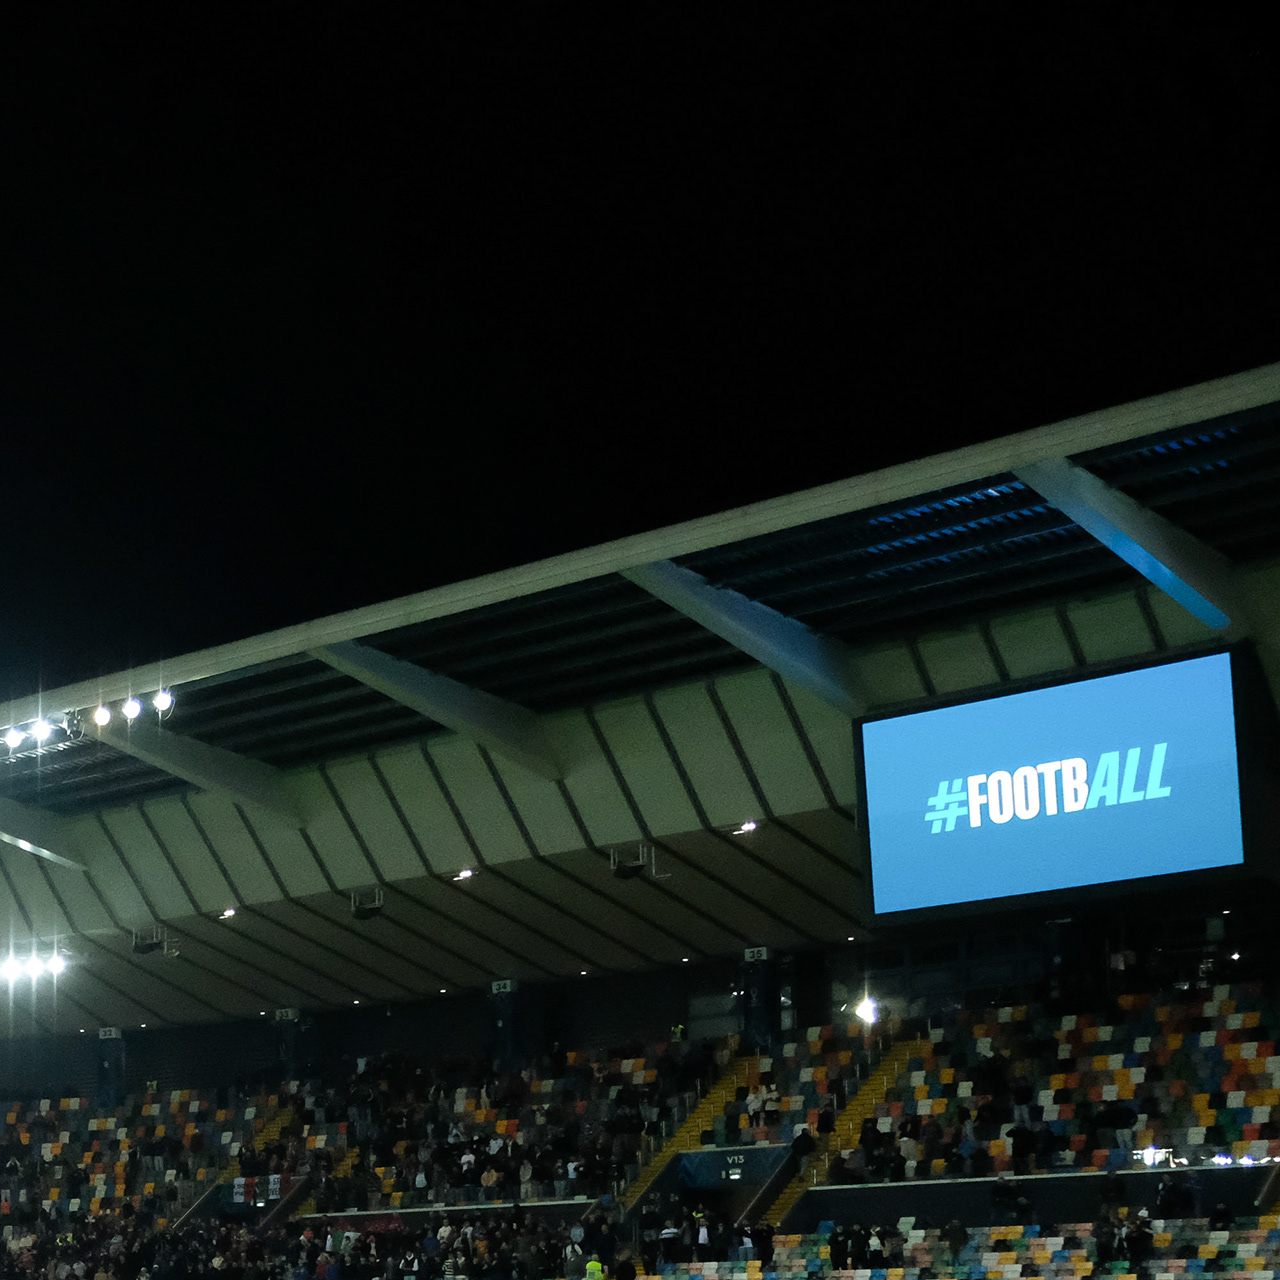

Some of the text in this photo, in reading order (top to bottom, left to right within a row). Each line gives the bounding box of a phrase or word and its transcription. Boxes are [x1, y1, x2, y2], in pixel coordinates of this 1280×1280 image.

[924, 743, 1171, 834] #FOOTBALL
[749, 949, 763, 959] 35
[496, 983, 507, 991] 34
[102, 1029, 113, 1037] 32
[726, 1155, 744, 1164] V13
